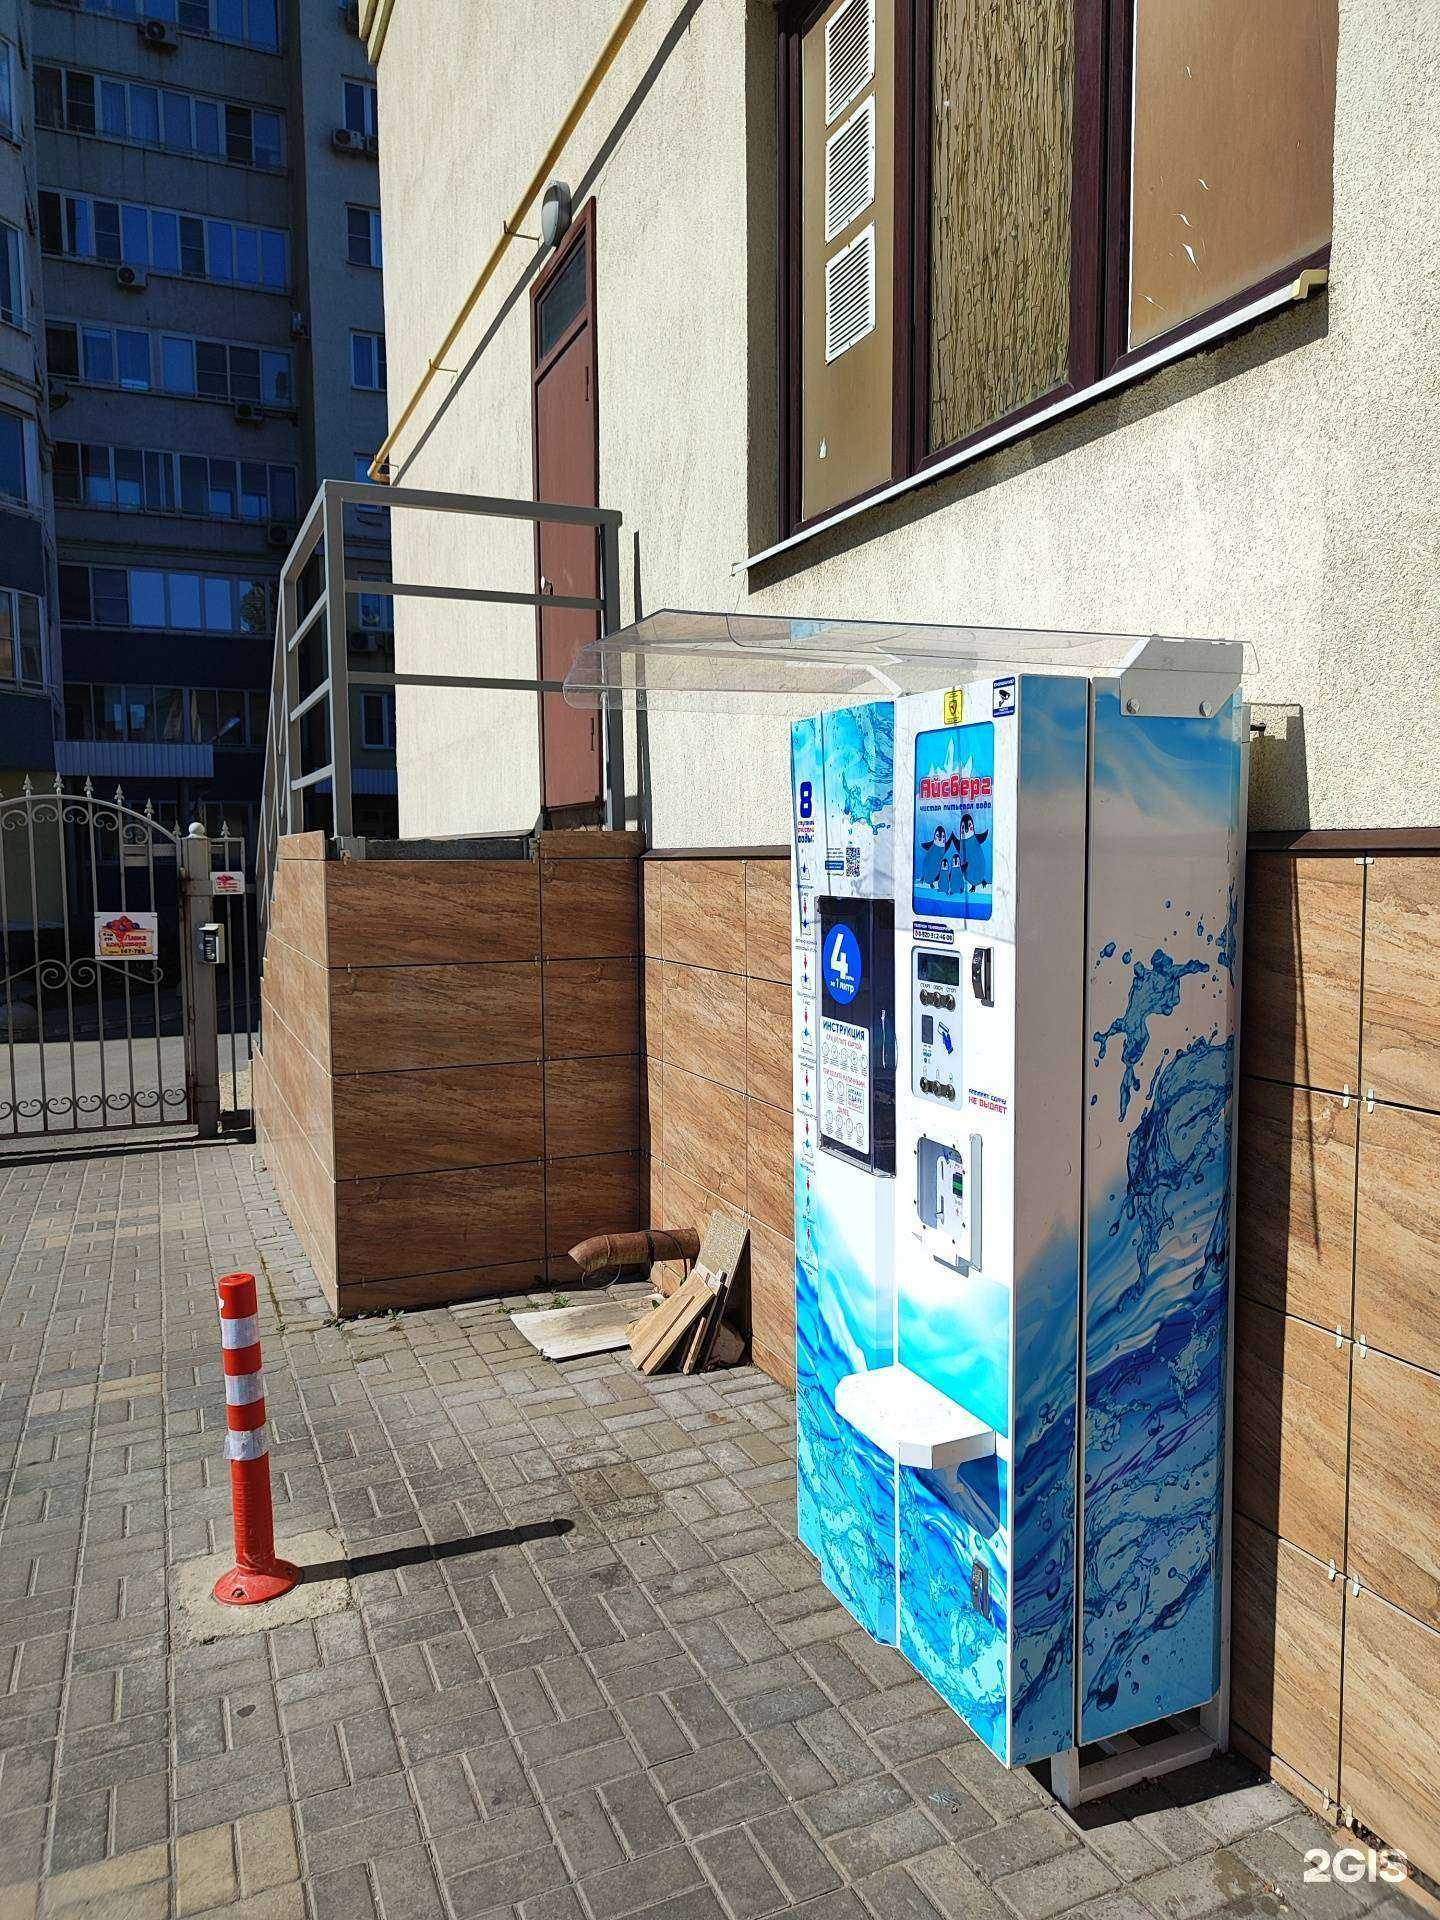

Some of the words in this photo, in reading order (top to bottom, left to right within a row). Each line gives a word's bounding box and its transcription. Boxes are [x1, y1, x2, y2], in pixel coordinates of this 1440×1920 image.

[800, 781, 812, 818] 8
[831, 933, 848, 979] 4
[839, 982, 855, 995] литр
[823, 1019, 865, 1041] ИНСТРУКЦИЯ
[969, 1095, 978, 1105] НЕ
